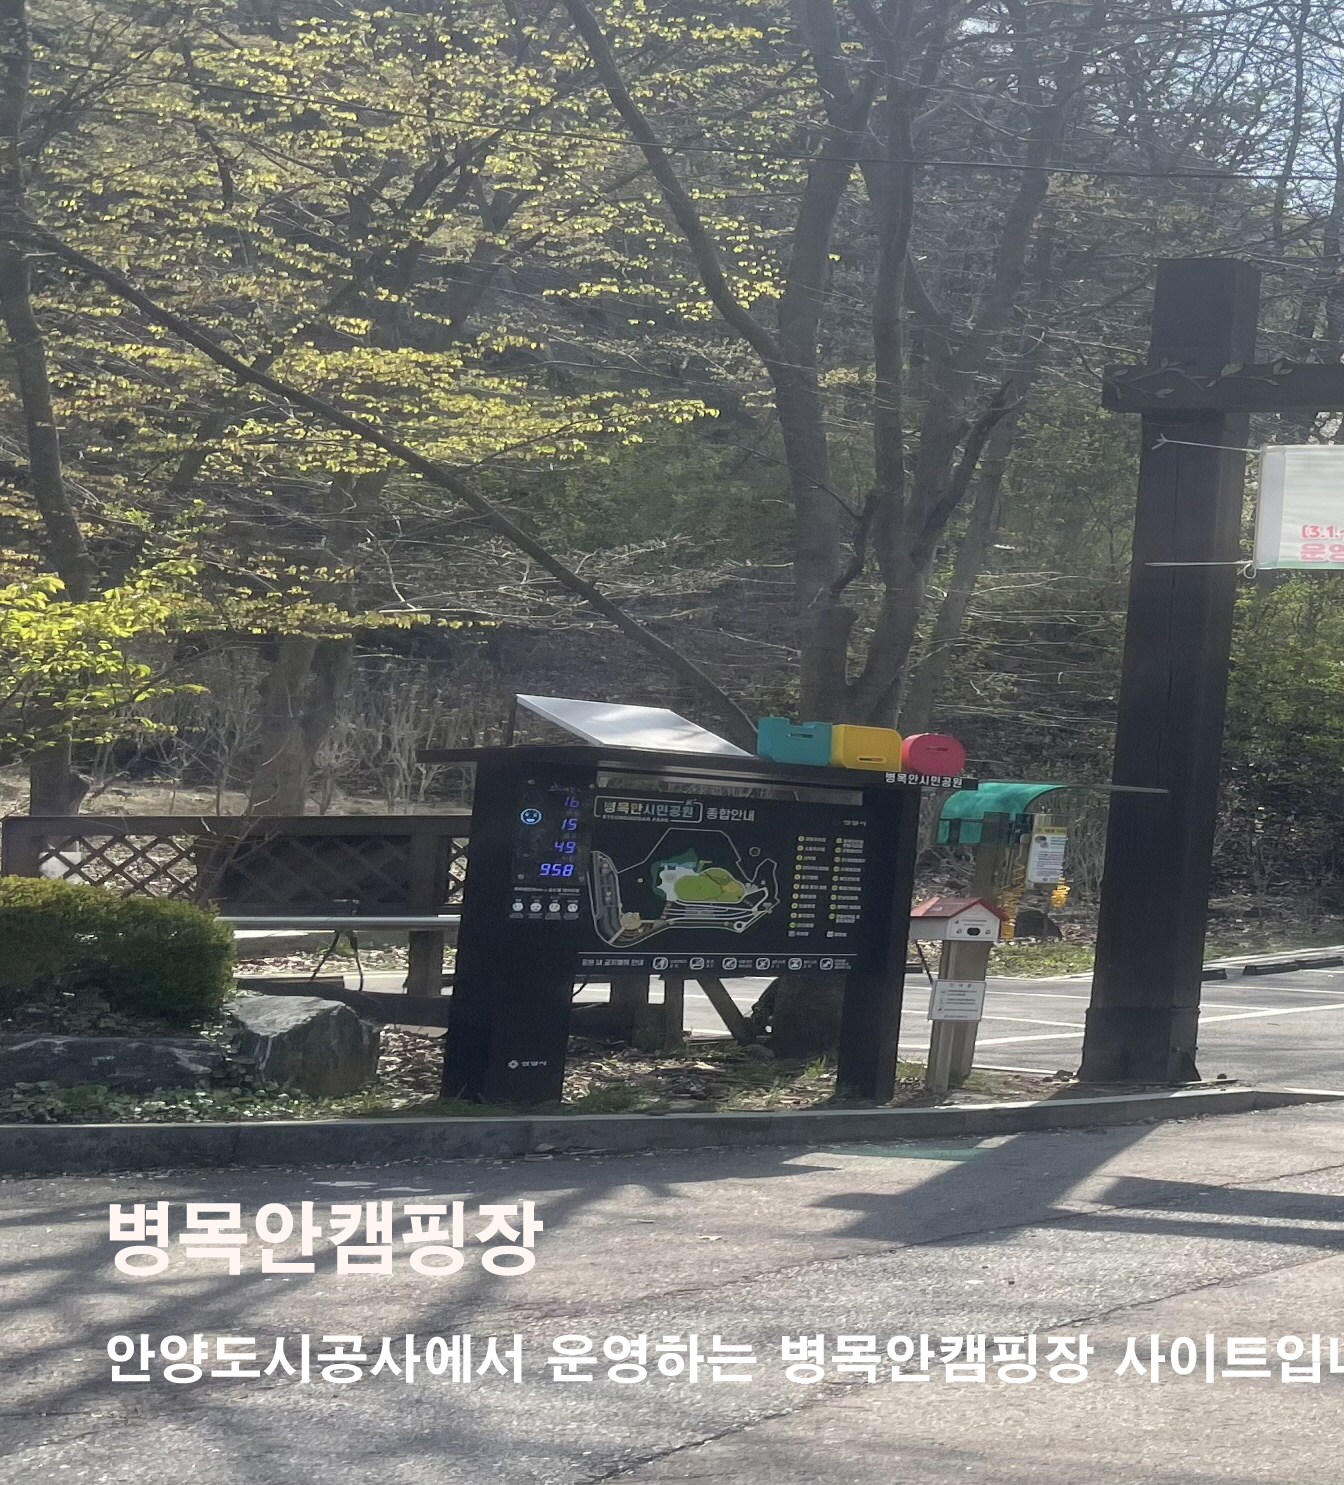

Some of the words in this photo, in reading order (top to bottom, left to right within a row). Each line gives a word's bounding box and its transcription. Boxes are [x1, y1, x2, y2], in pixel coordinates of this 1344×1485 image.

[885, 772, 963, 788] 병목안시민공원
[706, 807, 755, 822] 종합안내
[540, 863, 574, 877] 958
